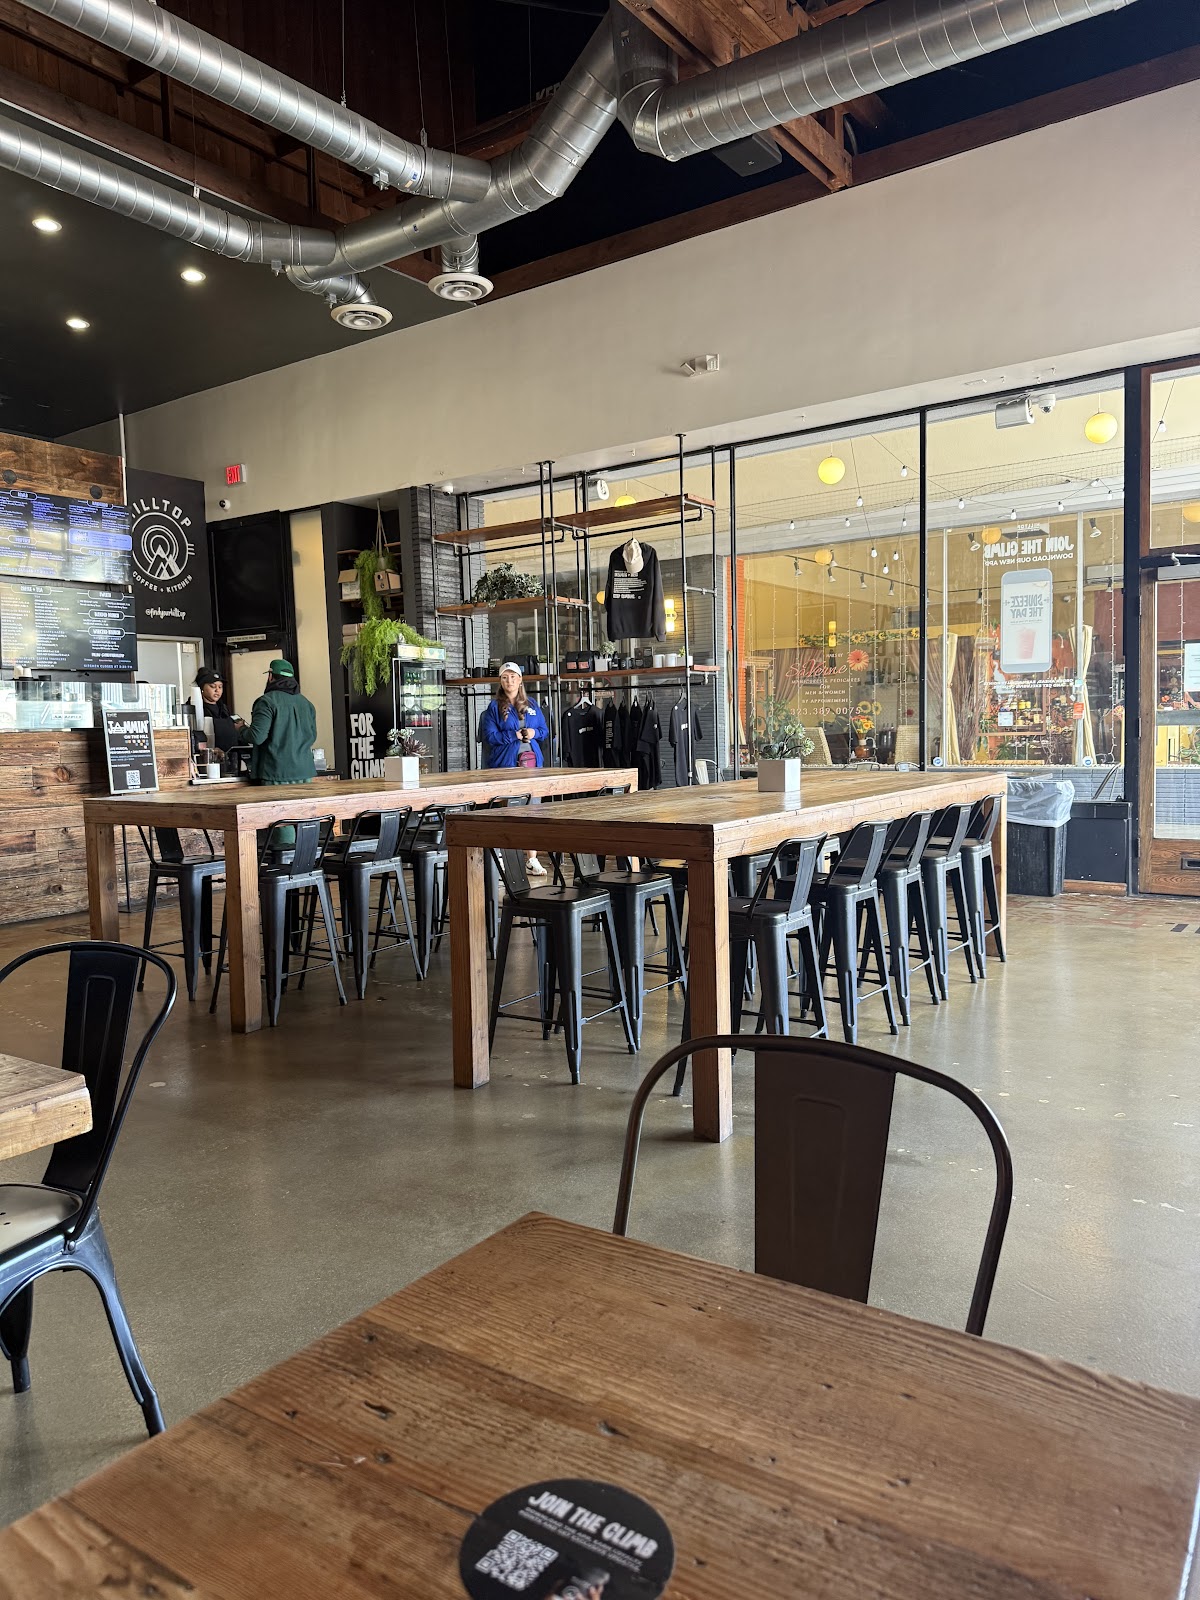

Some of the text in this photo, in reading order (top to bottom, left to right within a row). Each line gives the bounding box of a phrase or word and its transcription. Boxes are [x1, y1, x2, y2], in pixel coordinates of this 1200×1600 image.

[226, 465, 240, 484] EXIT
[131, 497, 191, 527] ILLTOP
[132, 571, 158, 592] COFFEE
[166, 575, 193, 593] KITCHEN
[145, 606, 186, 620] @findyourhilltop
[790, 706, 861, 716] 323.389.0075
[350, 712, 376, 737] FOR
[350, 735, 375, 760] THE
[528, 1491, 658, 1559] JOIN THE CLIMB
